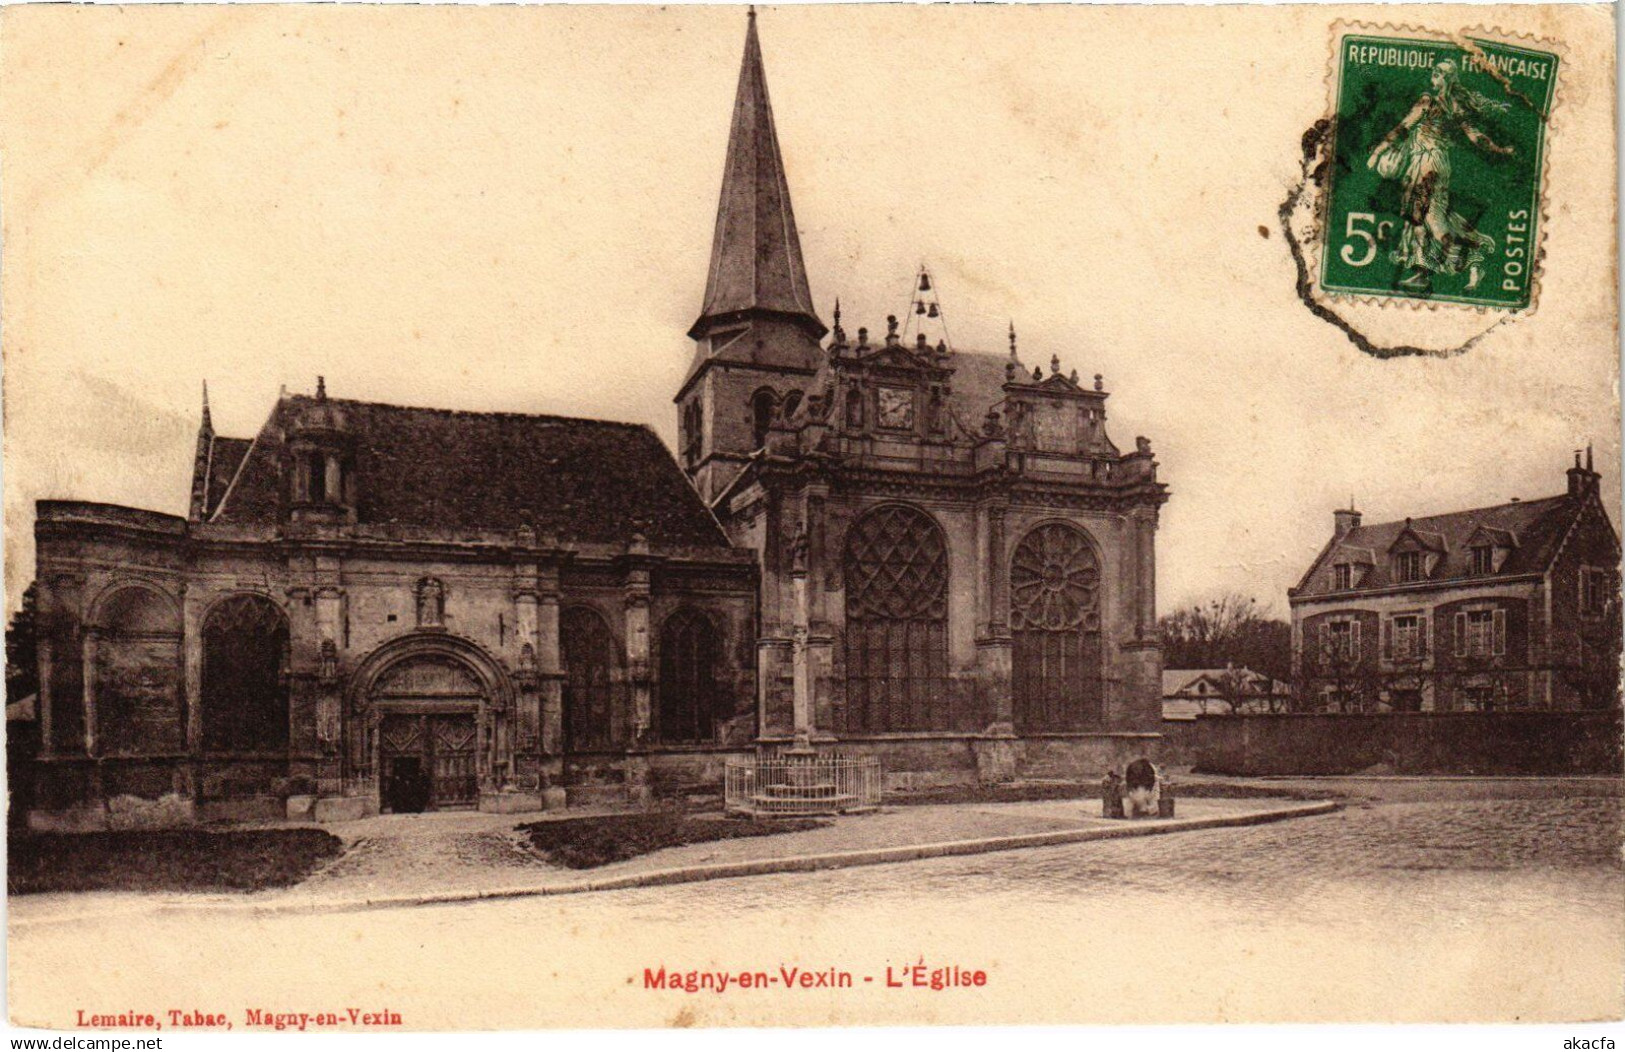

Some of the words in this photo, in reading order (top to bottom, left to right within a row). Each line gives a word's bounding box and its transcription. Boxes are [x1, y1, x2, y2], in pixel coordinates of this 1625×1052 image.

[1350, 45, 1436, 70] REPUBLIQUE
[1502, 210, 1528, 291] POSTES
[643, 967, 853, 993] Magny-en-Vexin
[886, 955, 987, 991] L'Église
[76, 1010, 162, 1031] Lemaire,
[168, 1009, 233, 1031] Tabac,
[245, 1008, 403, 1031] Magny-en-Vexin
